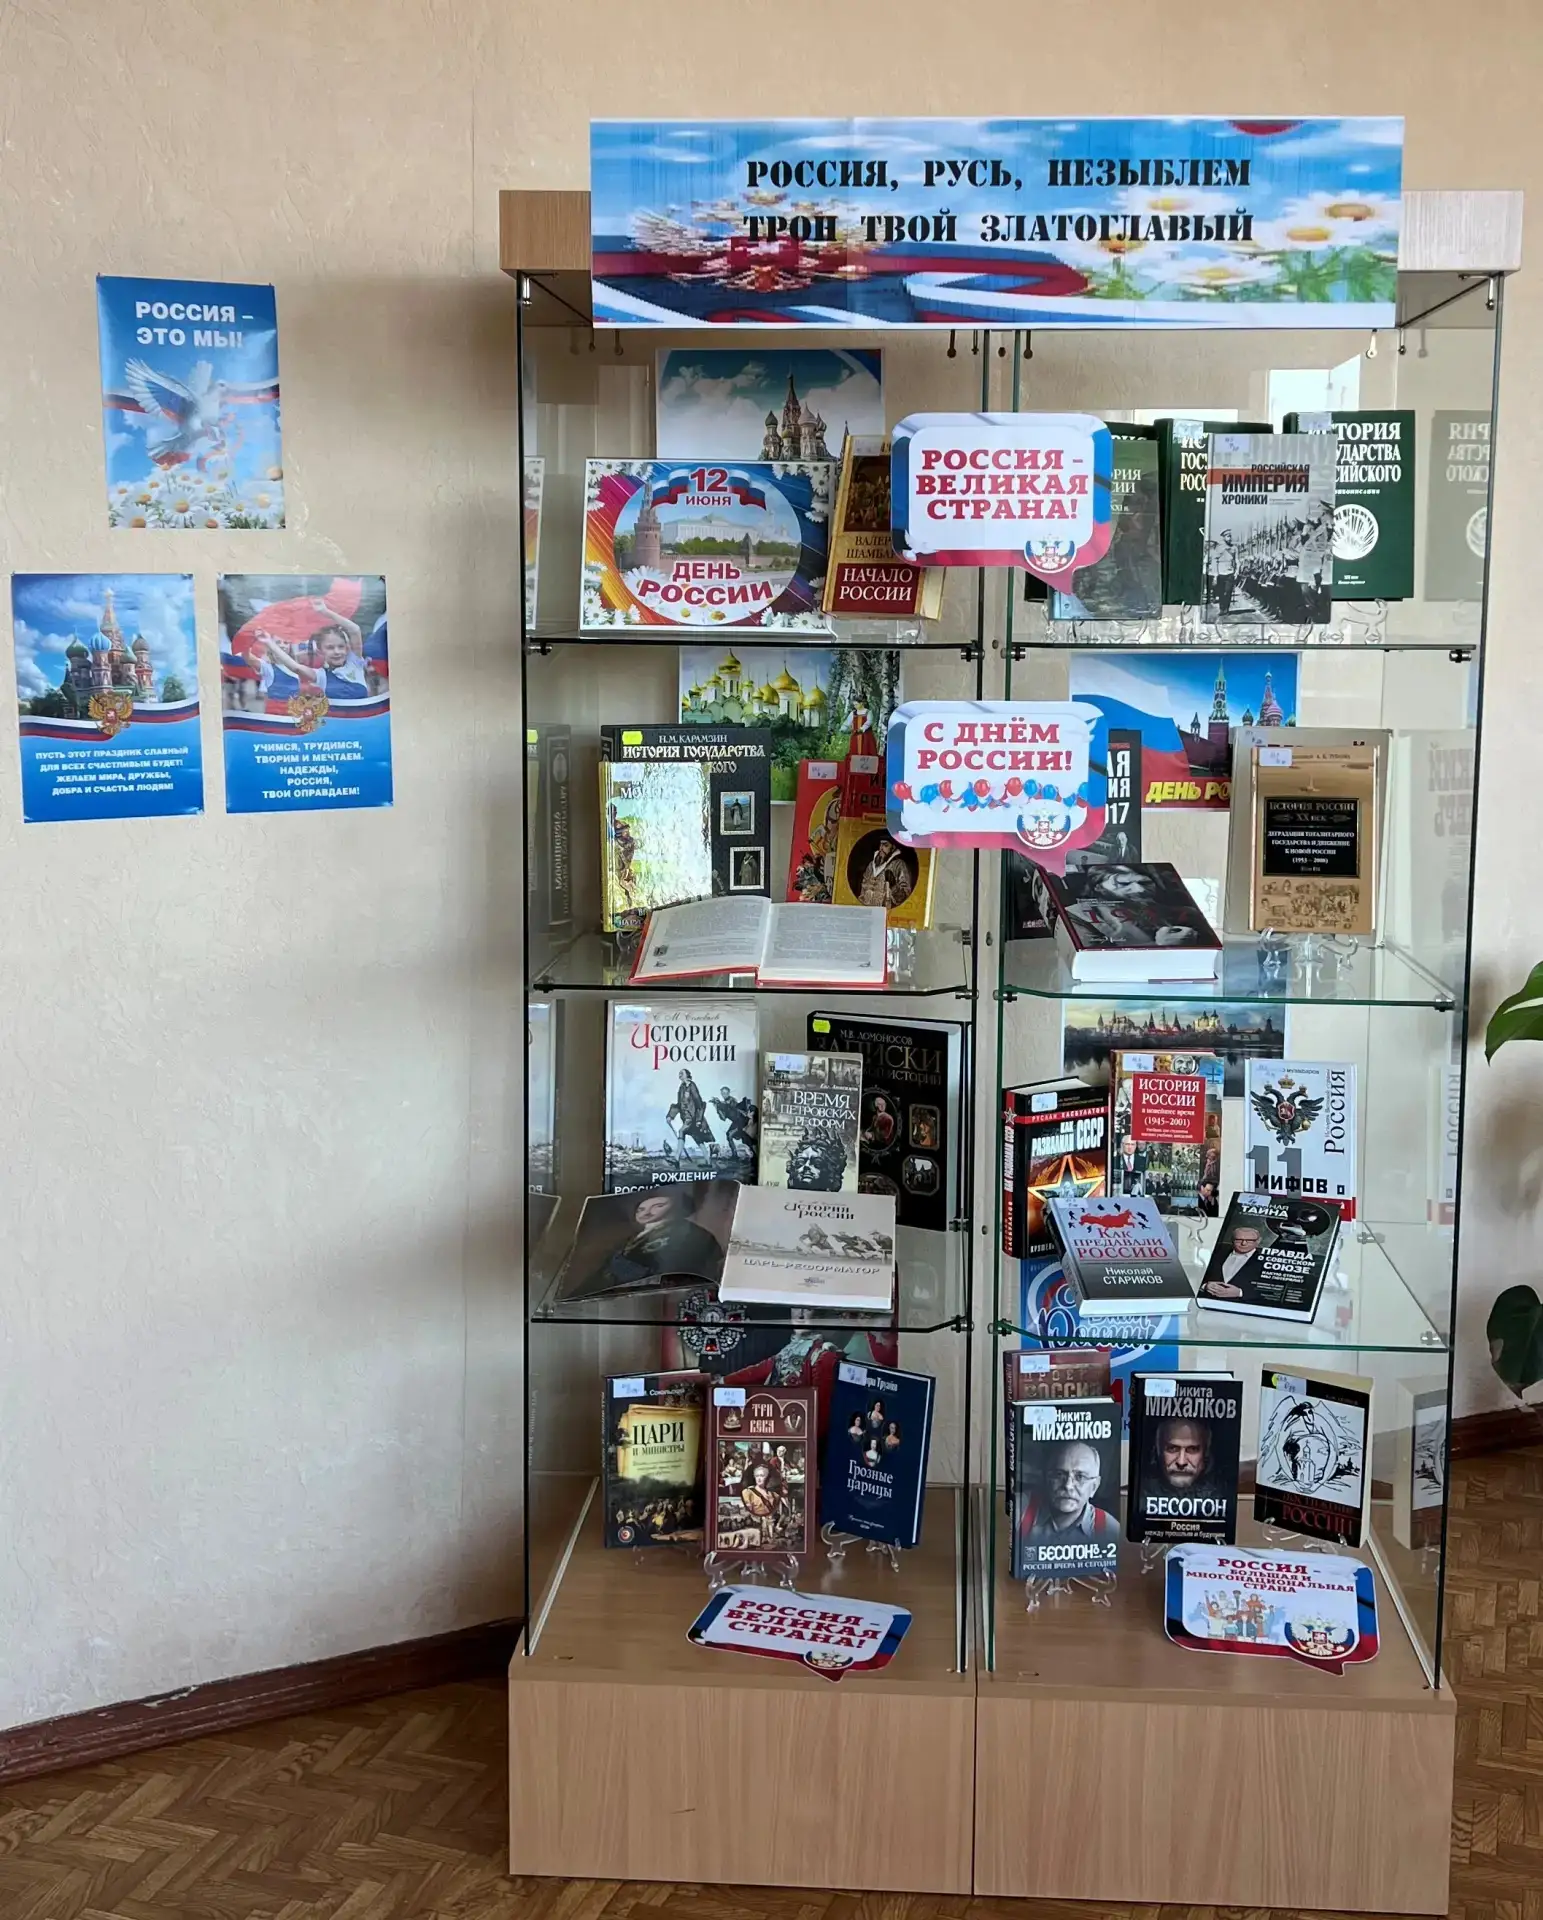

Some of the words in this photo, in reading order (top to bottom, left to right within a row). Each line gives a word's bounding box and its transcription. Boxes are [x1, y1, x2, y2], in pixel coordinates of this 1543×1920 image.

[747, 160, 900, 192] РОССИЯ,
[923, 158, 1022, 192] РУСЬ,
[1047, 158, 1252, 188] НЕЗЫБЛЕМ
[743, 213, 838, 243] ТРОН
[860, 207, 957, 243] ТВОЙ
[980, 206, 1255, 243] ЗЛАТОГЛАВЫЙ
[135, 300, 236, 323] РОССИЯ
[136, 326, 190, 347] ЭТО
[194, 328, 244, 349] МЫ!
[921, 449, 1064, 470] РОССИЯ
[1251, 463, 1310, 473] РОССИЙСКАЯ
[690, 468, 729, 492] 12
[915, 474, 1089, 495] ВЕЛИКАЯ
[1221, 474, 1310, 493] ИМПЕРИЯ
[685, 495, 732, 506] ИЮНЯ
[1221, 494, 1268, 505] ХРОНИКИ
[926, 498, 1078, 519] СТРАНА!
[672, 562, 741, 583] ДЕНЬ
[842, 568, 913, 583] НАЧАЛО
[638, 579, 774, 605] РОССИИ
[839, 586, 912, 601] РОССИИ
[679, 734, 728, 744] КАРАМЗИН
[924, 722, 944, 743] С
[953, 717, 1060, 746] ДНЁМ
[35, 751, 65, 760] ПУСТЬ
[67, 751, 91, 759] ЭТОТ
[93, 749, 142, 758] ПРАЗДНИК
[143, 746, 189, 756] СЛАВНЫЙ
[253, 743, 300, 752] УЧИМСЯ,
[303, 741, 363, 751] ТРУДИМСЯ,
[622, 745, 681, 759] ИСТОРИЯ
[683, 745, 766, 761] ГОСУДАРСТВА
[40, 764, 59, 772] ДЛЯ
[61, 763, 85, 771] ВСЕХ
[87, 761, 151, 770] СЧАСТЛИВЫМ
[152, 759, 184, 768] БУДЕТ!
[255, 754, 299, 764] ТВОРИМ
[301, 754, 310, 762] И
[312, 753, 364, 762] МЕЧТАЕМ.
[917, 749, 1073, 771] РОССИИ!
[56, 774, 97, 783] ЖЕЛАЕМ
[98, 773, 126, 781] МИРА,
[127, 772, 172, 781] ДРУЖБЫ,
[279, 765, 339, 775] НАДЕЖДЫ,
[287, 777, 333, 786] РОССИЯ,
[52, 786, 83, 796] ДОБРА
[93, 784, 135, 793] СЧАСТЬЯ
[136, 783, 174, 792] ЛЮДЯМ!
[262, 789, 291, 799] ТВОИ
[293, 787, 360, 797] ОПРАВДАЕМ!
[1145, 781, 1202, 804] ДЕНЬ
[1269, 801, 1313, 811] ИСТОРИЯ
[1315, 802, 1355, 811] РОССИИ
[630, 1023, 730, 1049] ИСТОРИЯ
[857, 1031, 913, 1046] ЛОМОНОСОВ
[652, 1045, 737, 1070] РОССИИ
[1138, 1078, 1200, 1093] ИСТОРИЯ
[793, 1090, 850, 1109] ВРЕМЯ
[1141, 1093, 1197, 1107] РОССИИ
[780, 1103, 856, 1120] ПЕТРОВСКИХ
[1031, 1114, 1058, 1122] РУСЛАН
[1061, 1107, 1106, 1119] ХАСБУЛАТОВ
[794, 1115, 845, 1130] РЕФОРМ
[1060, 1121, 1075, 1134] КАК
[1076, 1117, 1105, 1151] СССР
[651, 1171, 718, 1184] РОЖДЕНИЕ
[1246, 1144, 1303, 1199] 11
[1254, 1173, 1329, 1195] МИФОВ
[1073, 1238, 1164, 1247] ПРЕДАВАЛИ
[1076, 1246, 1168, 1260] РОССИЮ
[1261, 1247, 1314, 1261] ПРАВДА
[743, 1257, 881, 1275] ЦАРЬ-РЕФОРМАТОР
[1263, 1261, 1311, 1275] СОЮЗЕ
[1267, 1255, 1316, 1267] СОВЕТСКОМ
[1104, 1266, 1154, 1275] Николай
[1102, 1275, 1164, 1286] СТАРИКОВ
[632, 1421, 685, 1446] ЦАРИ
[641, 1443, 685, 1455] МИНИСТРЫ
[848, 1458, 894, 1485] Грозные
[846, 1476, 893, 1499] царицы
[1146, 1496, 1227, 1518] БЕСОГОН
[1170, 1521, 1201, 1531] Россия
[1217, 1557, 1308, 1574] РОССИЯ
[1185, 1570, 1355, 1593] МНОГОНАЦИОНАЛЬНАЯ
[1229, 1568, 1297, 1582] БОЛЬШАЯ
[1303, 1574, 1312, 1582] И
[1243, 1582, 1298, 1594] СТРАНА
[736, 1599, 864, 1627] РОССИЯ
[724, 1608, 882, 1640] ВЕЛИКАЯ
[728, 1620, 867, 1649] СТРАНА!
